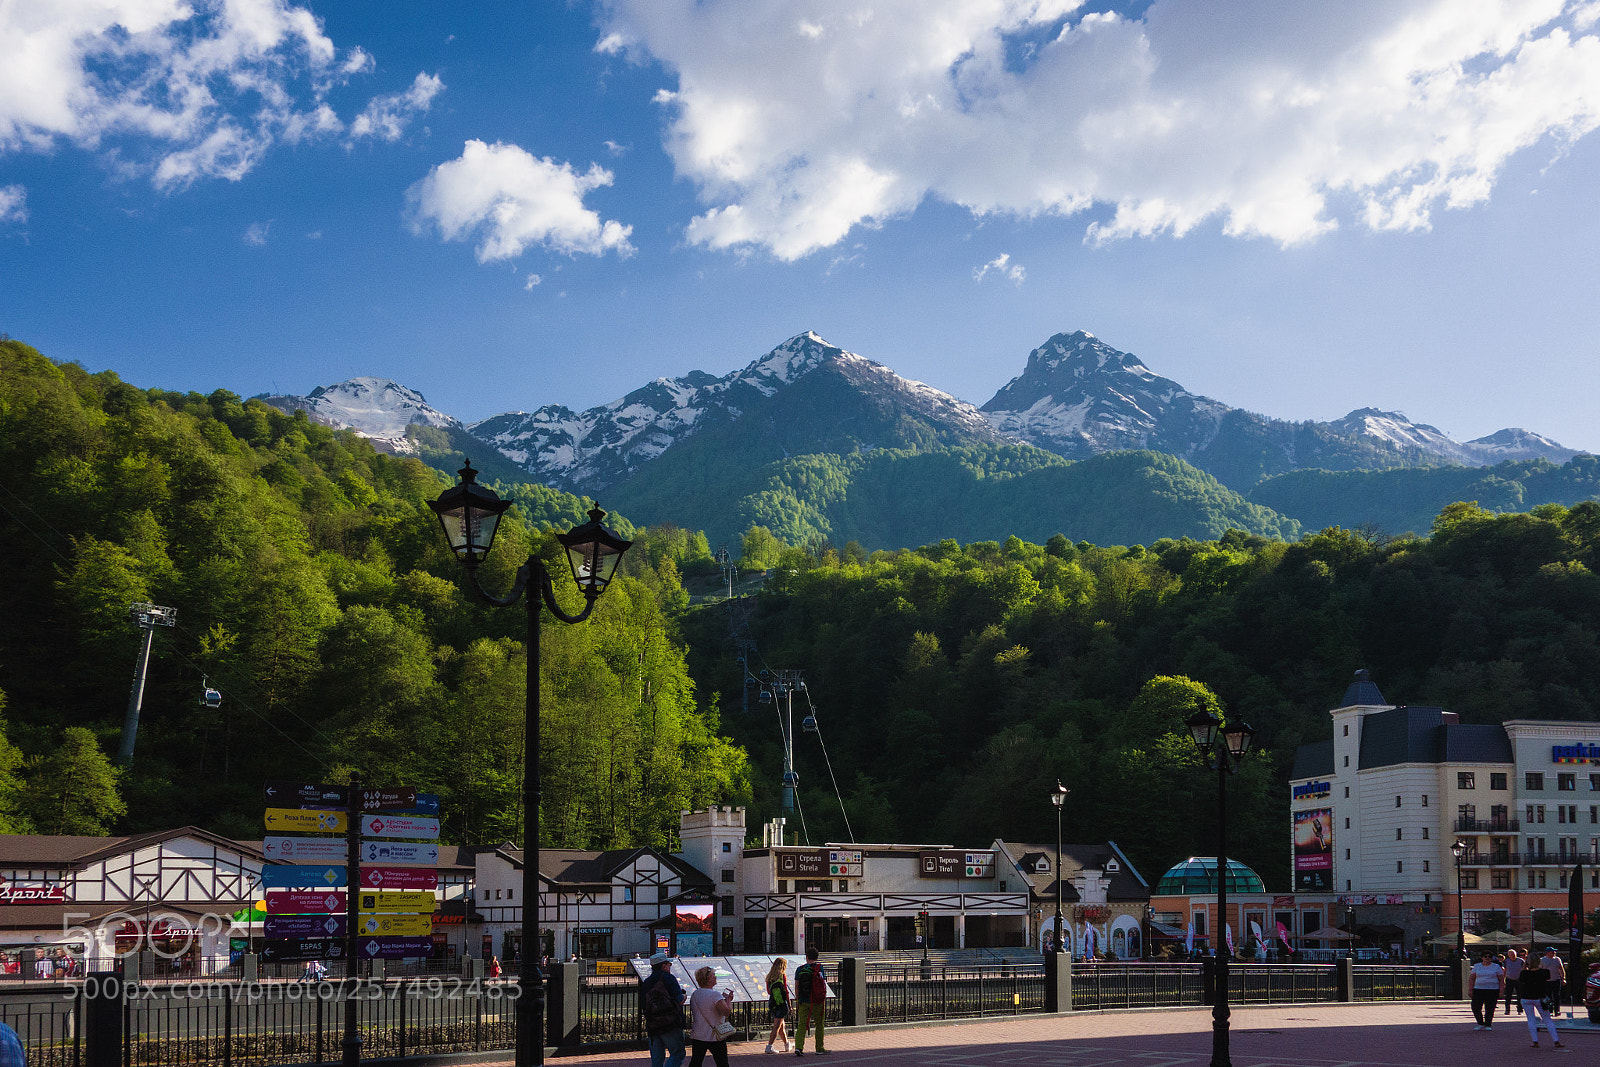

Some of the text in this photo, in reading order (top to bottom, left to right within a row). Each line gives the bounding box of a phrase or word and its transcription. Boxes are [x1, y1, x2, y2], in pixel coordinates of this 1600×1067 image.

[1552, 742, 1589, 763] park
[799, 854, 822, 863] Стрела
[939, 856, 958, 865] Тироль
[799, 864, 819, 872] Strela
[939, 865, 953, 873] Tirol
[300, 942, 323, 950] ESPAS
